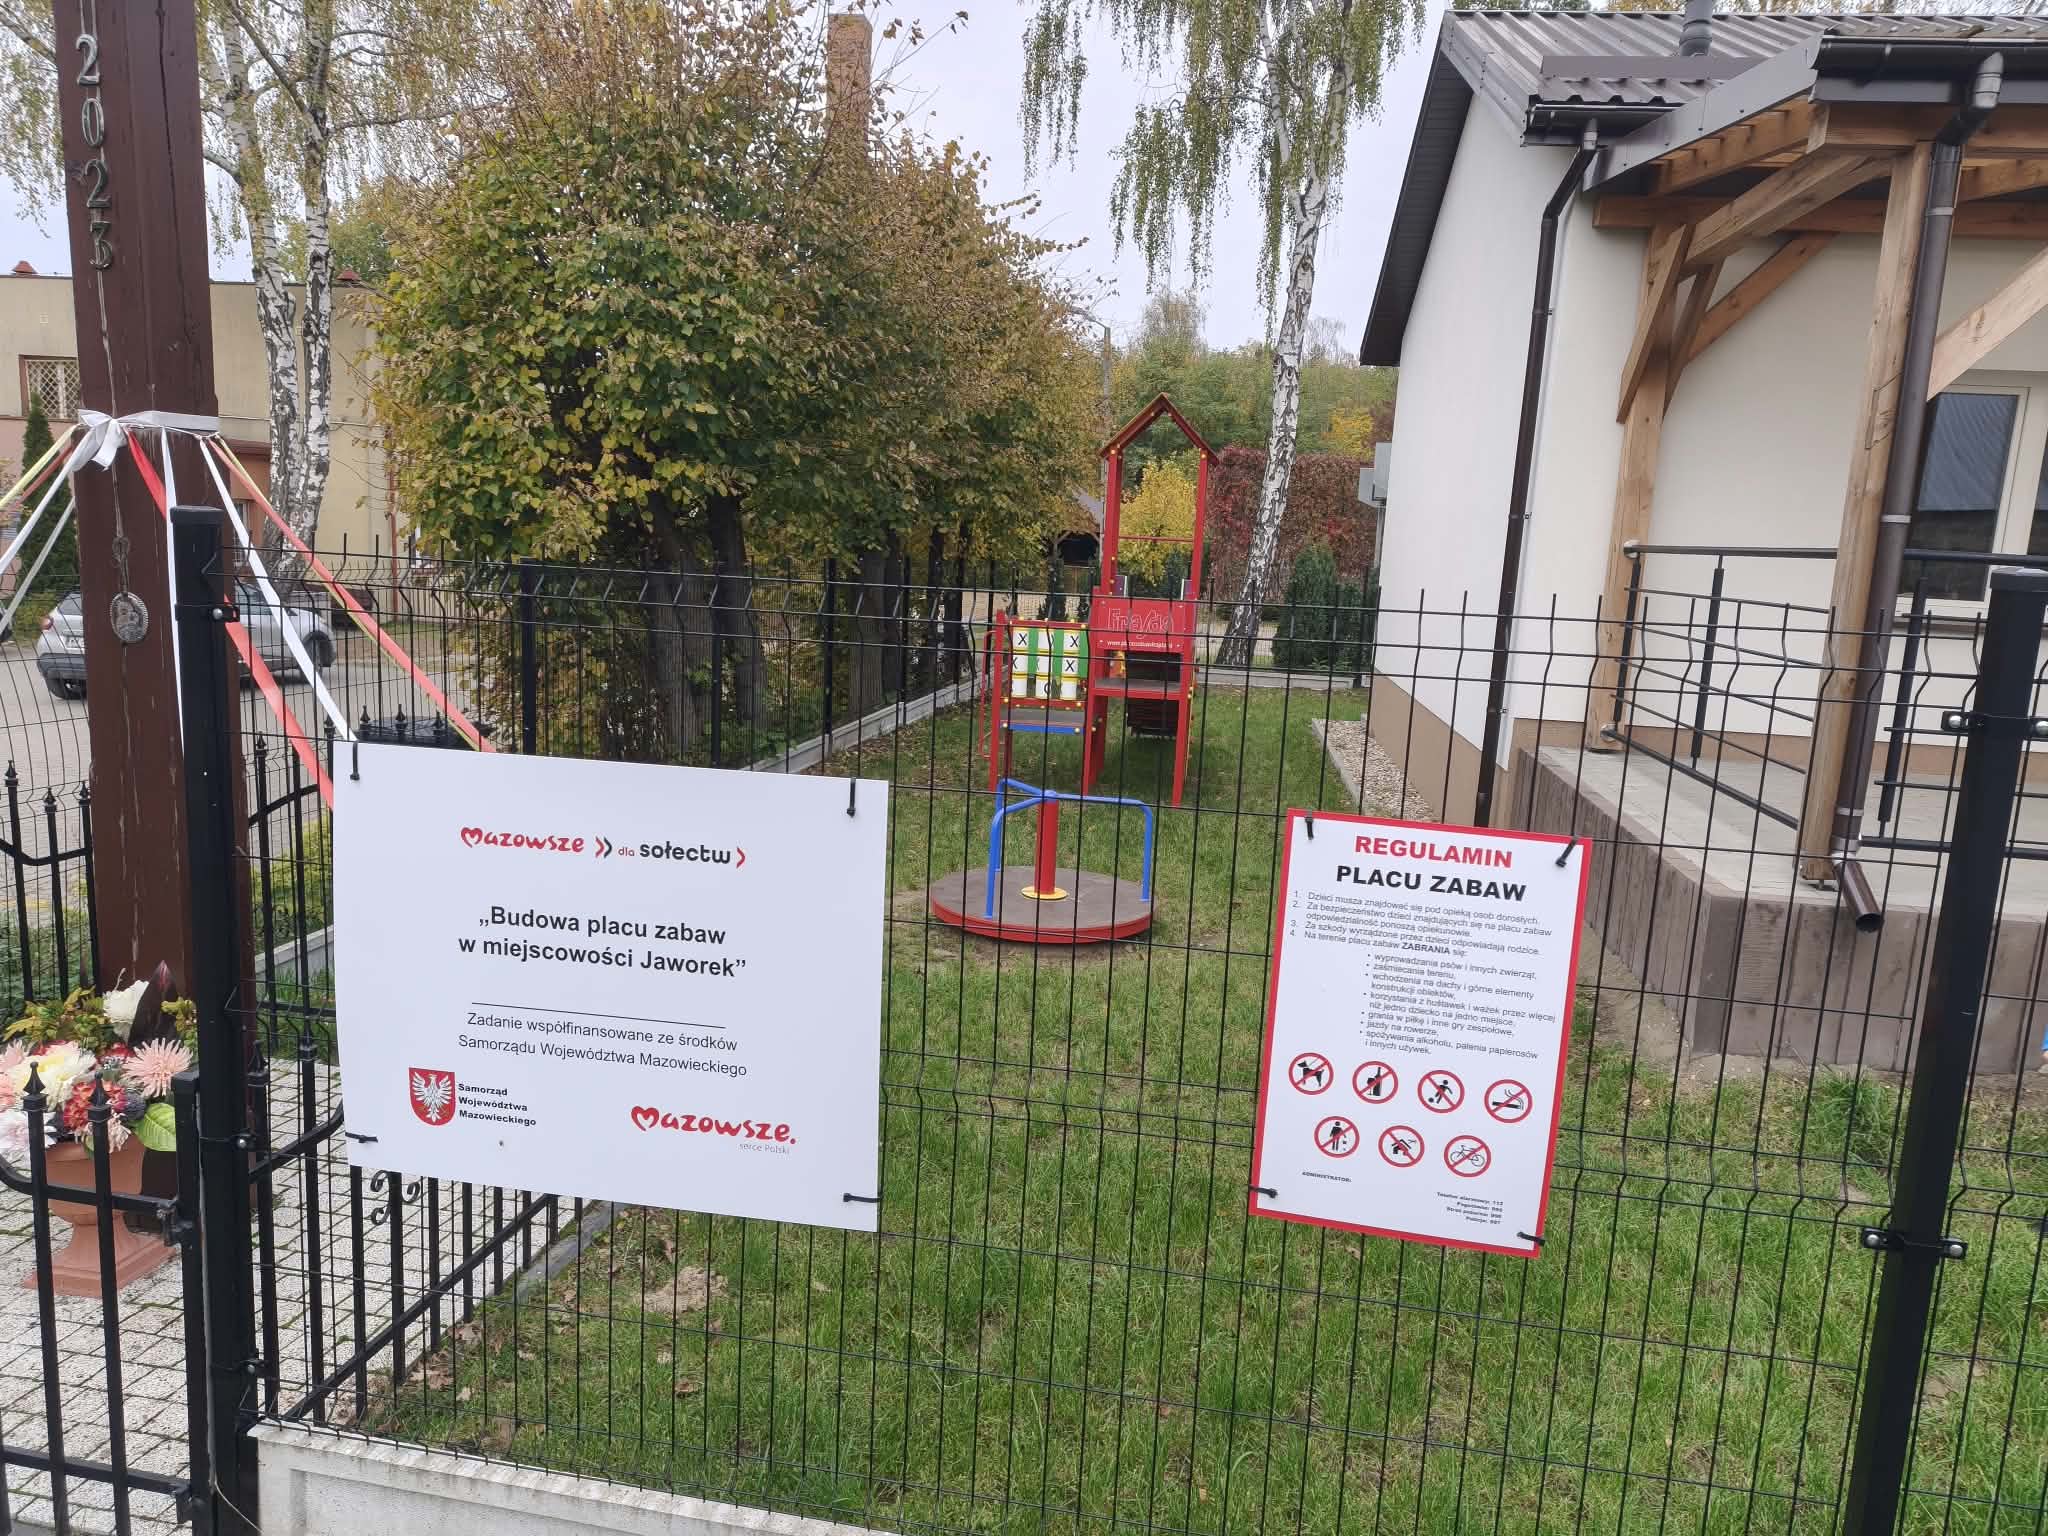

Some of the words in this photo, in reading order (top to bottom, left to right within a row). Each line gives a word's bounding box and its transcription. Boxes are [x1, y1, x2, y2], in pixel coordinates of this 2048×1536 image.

[76, 33, 113, 270] 2023
[460, 827, 585, 853] Mazowsze
[617, 846, 635, 857] dla
[639, 840, 731, 865] sołectw
[1355, 835, 1513, 869] REGULAMIN
[1336, 865, 1422, 890] PLACU
[1429, 875, 1527, 902] ZABAW
[1307, 901, 1318, 910] Za
[1498, 923, 1521, 934] placu
[1523, 927, 1553, 936] zabaw
[1308, 892, 1333, 902] Dzieci
[1425, 906, 1441, 915] pod
[479, 906, 580, 932] „Budowa
[587, 916, 648, 938] placu
[654, 923, 726, 945] zabaw
[1304, 931, 1316, 939] Na
[1348, 937, 1371, 947] placu
[1372, 939, 1399, 949] zabaw
[1401, 942, 1450, 954] ZABRANIA
[1305, 920, 1316, 929] Za
[1318, 923, 1346, 935] szkody
[1400, 933, 1424, 943] przez
[1425, 935, 1450, 944] dzieci
[458, 937, 476, 953] w
[483, 937, 633, 968] miejscowości
[640, 951, 747, 977] Jaworek”
[1423, 979, 1434, 987] na
[1495, 987, 1535, 1000] elementy
[1502, 1008, 1526, 1019] przez
[467, 1012, 523, 1031] Zadanie
[526, 1019, 654, 1044] współfinansowane
[657, 1032, 675, 1045] ze
[678, 1032, 738, 1052] środków
[458, 1035, 536, 1056] Samorządu
[540, 1041, 636, 1065] Województwa
[640, 1053, 748, 1078] Mazowieckiego
[458, 1083, 508, 1097] Samorząd
[458, 1096, 528, 1112] Województwa
[459, 1109, 537, 1127] Mazowieckiego
